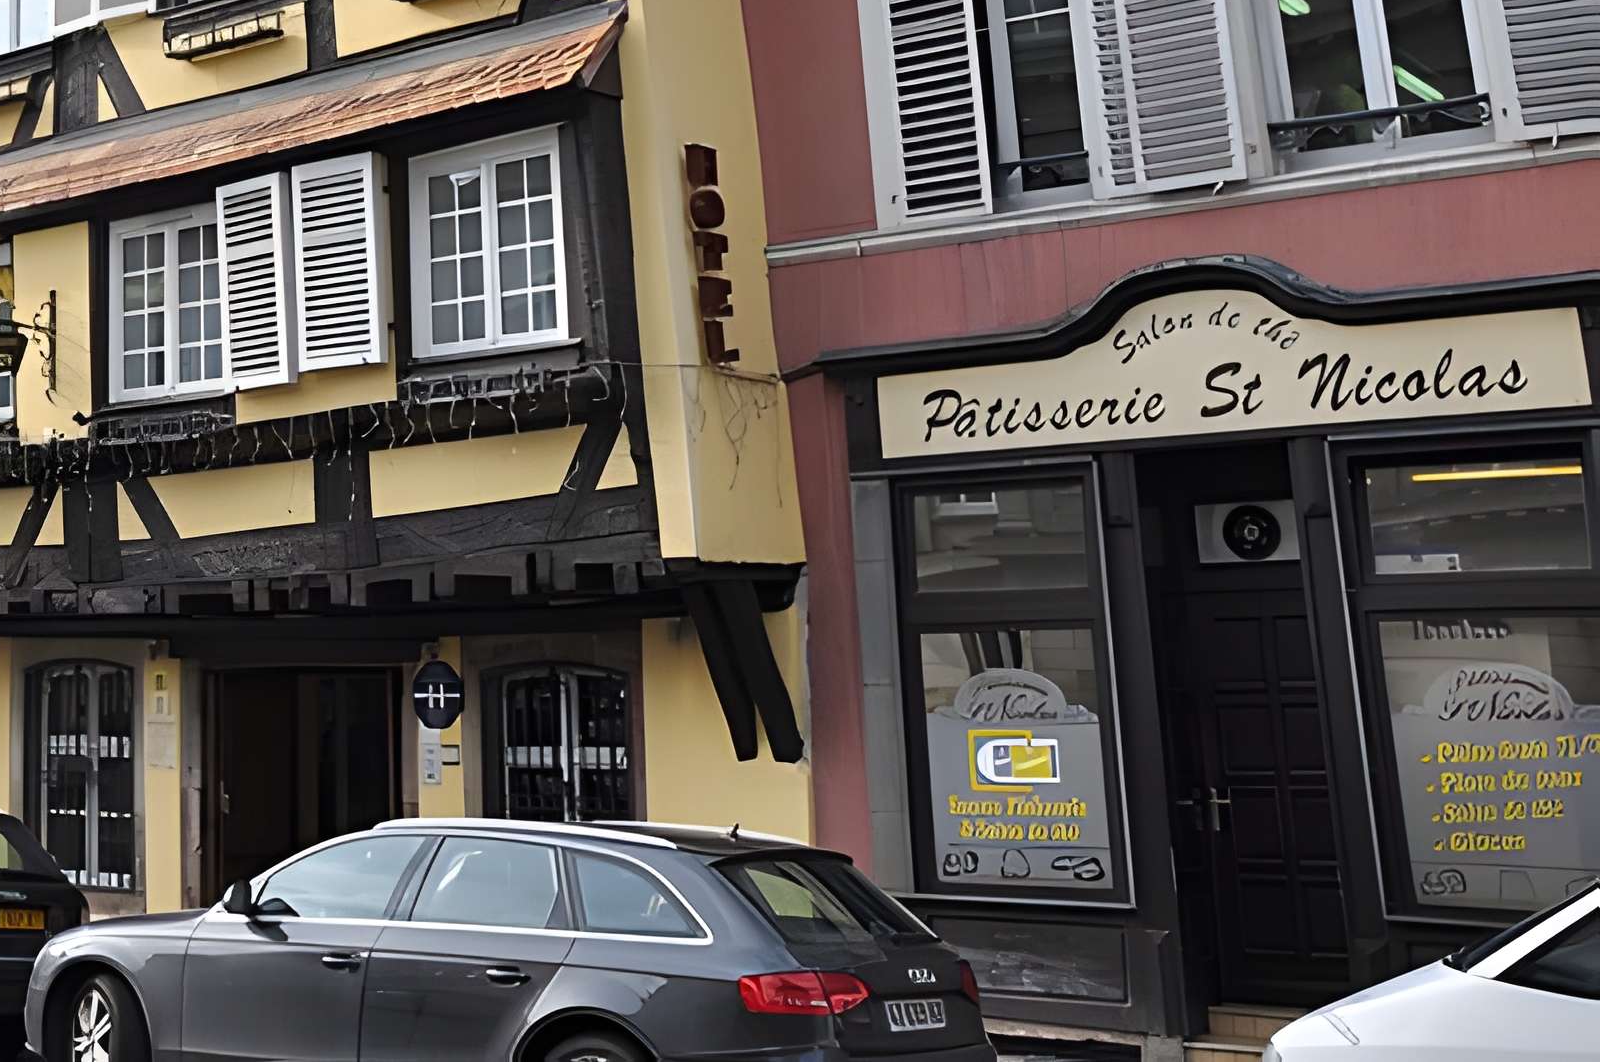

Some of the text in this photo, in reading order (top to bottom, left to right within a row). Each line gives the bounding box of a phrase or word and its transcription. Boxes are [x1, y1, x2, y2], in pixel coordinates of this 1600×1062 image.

[923, 348, 1529, 442] Pâtisserie St Nicolas
